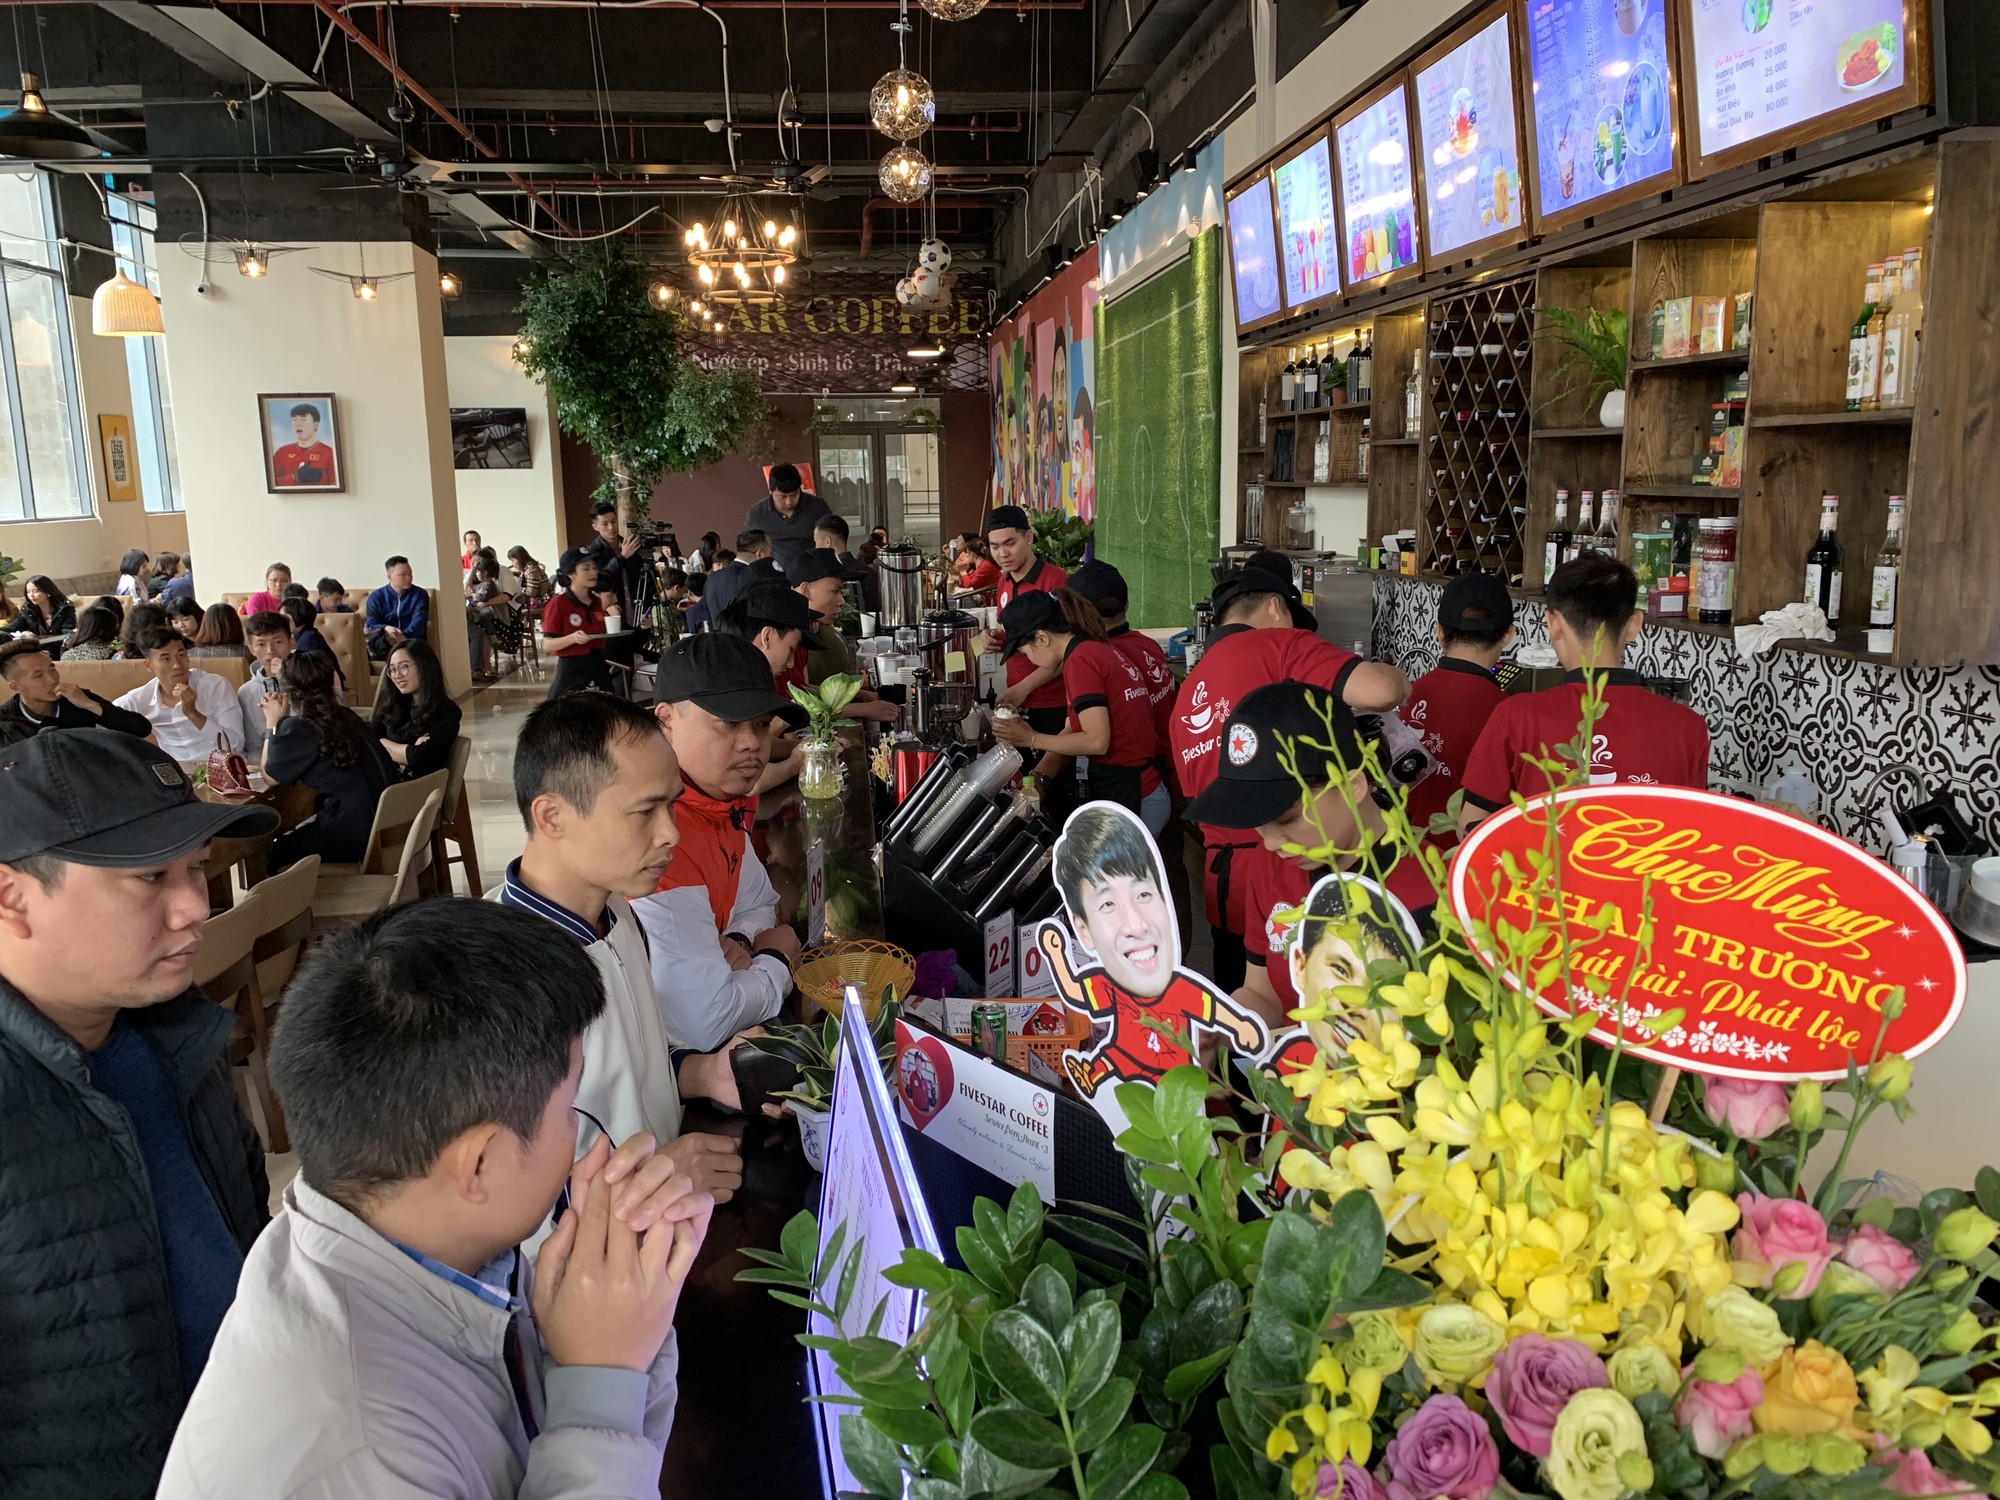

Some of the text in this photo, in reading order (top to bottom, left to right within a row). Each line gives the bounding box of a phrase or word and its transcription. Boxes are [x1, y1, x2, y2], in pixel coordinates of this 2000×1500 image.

[804, 297, 988, 335] COFFEE
[788, 352, 829, 371] Sinh
[836, 349, 855, 371] tố
[811, 867, 822, 906] 09
[1568, 804, 1895, 961] Chúc Mừng
[1022, 929, 1034, 938] NO:
[1500, 877, 1909, 1014] KHAI TRƯƠNG
[988, 935, 1010, 975] 22
[1700, 978, 1806, 1033] Phát
[1806, 1009, 1863, 1051] lộc
[959, 1081, 1007, 1118] FIVESTAR
[1009, 1108, 1049, 1139] COFFEE
